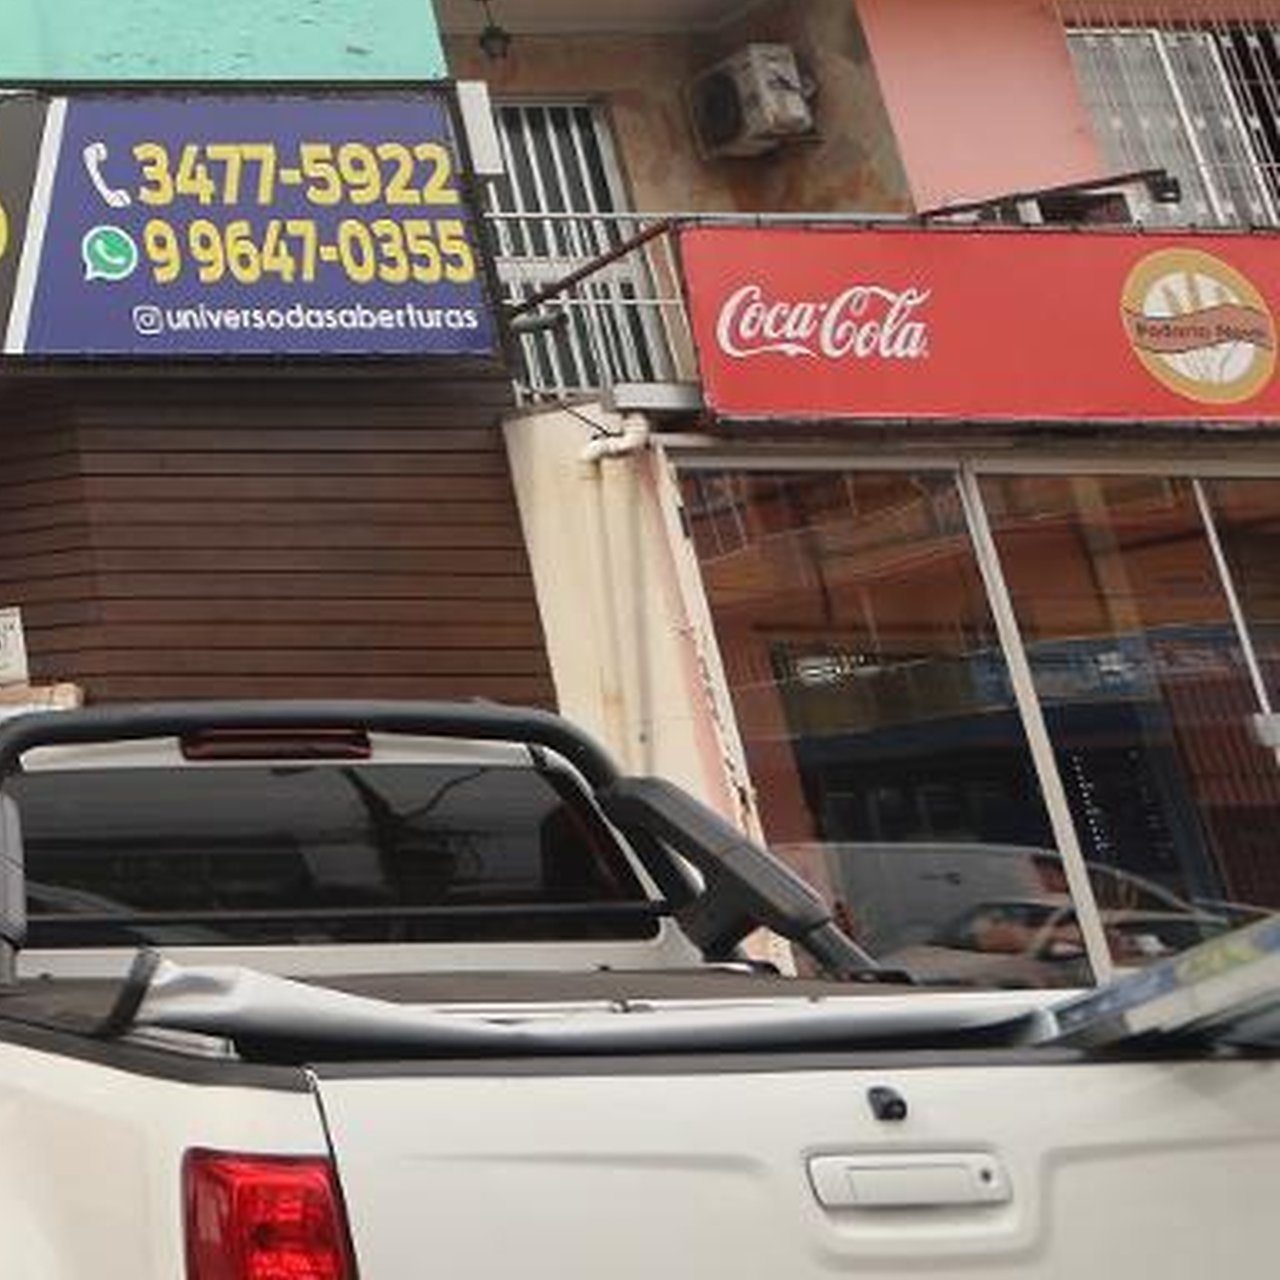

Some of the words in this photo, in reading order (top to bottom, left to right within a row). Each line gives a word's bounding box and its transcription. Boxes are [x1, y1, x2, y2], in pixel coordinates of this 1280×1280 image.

[133, 141, 460, 206] 3477-5922
[143, 219, 182, 283] 9
[188, 219, 476, 283] 9647-0355
[168, 302, 479, 331] universodasaberturas
[716, 285, 931, 359] Coca-Cola
